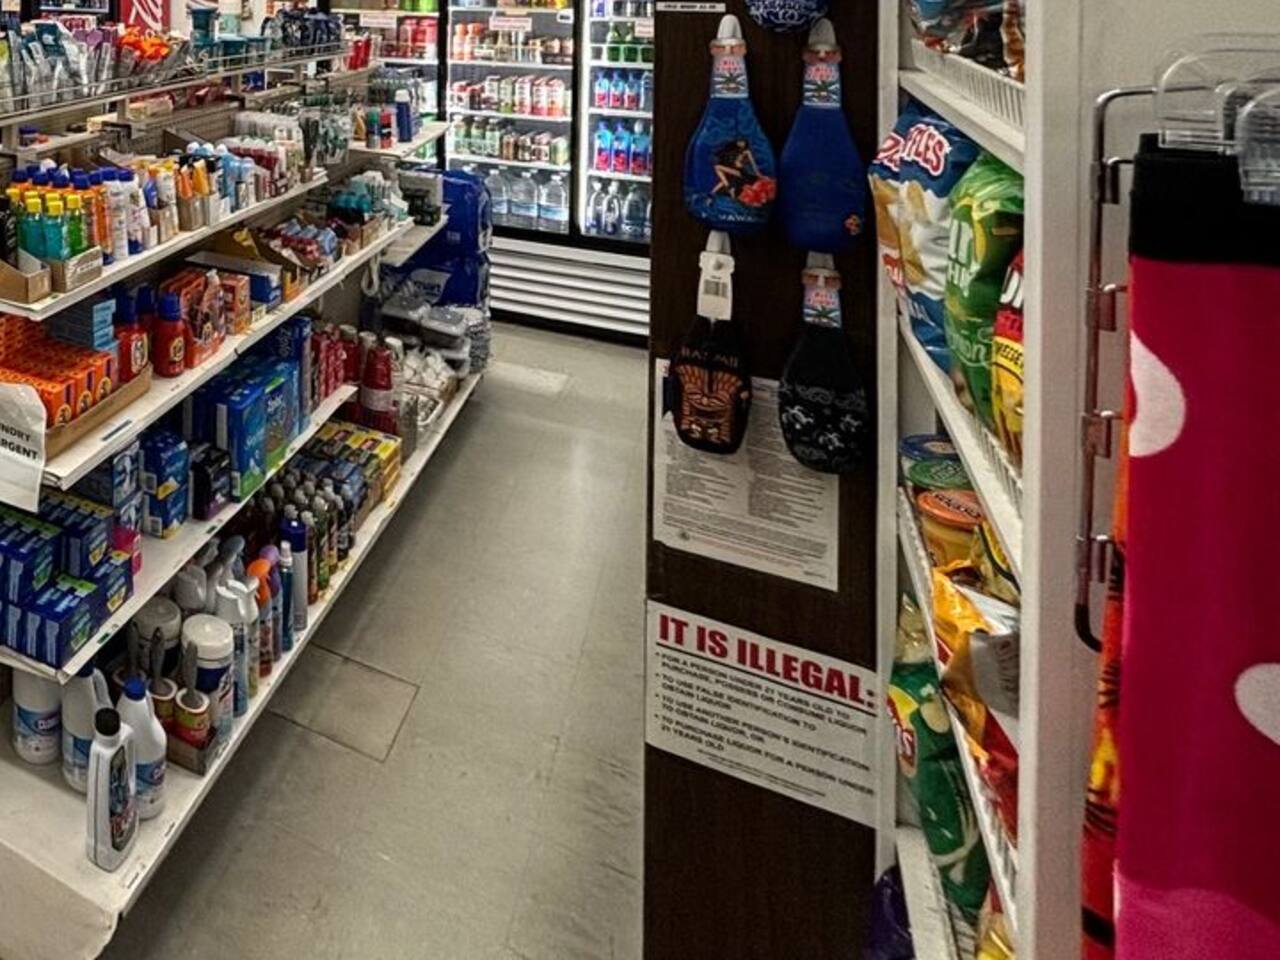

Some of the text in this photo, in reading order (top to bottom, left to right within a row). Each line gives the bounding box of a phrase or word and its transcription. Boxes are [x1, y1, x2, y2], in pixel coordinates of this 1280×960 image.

[659, 613, 876, 711] IT IS ILLEGAL:
[662, 683, 731, 711] OBTAIN LIQUOR
[662, 674, 673, 684] TO
[696, 685, 723, 700] FALSE
[727, 695, 800, 726] IDENTIFICATION
[803, 721, 815, 731] TO
[662, 703, 673, 712] TO
[676, 708, 708, 724] OBTAIN
[690, 662, 727, 679] PERSON
[730, 675, 761, 690] UNDER
[777, 691, 809, 707] YEARS
[812, 702, 832, 714] OLD
[836, 710, 849, 720] TO
[760, 693, 774, 704] OR
[777, 699, 824, 721] CONSUME
[828, 716, 866, 735] LIQUOR
[662, 695, 673, 704] TO
[676, 699, 692, 710] USE
[695, 706, 739, 726] ANOTHER
[792, 739, 869, 771] IDENTIFICATION
[662, 715, 672, 725] TO
[675, 720, 723, 742] PURCHASE
[726, 737, 761, 755] LIQUOR
[765, 750, 784, 763] FOR
[796, 762, 836, 781] PERSON
[673, 728, 702, 744] YEARS
[705, 739, 723, 751] OLD
